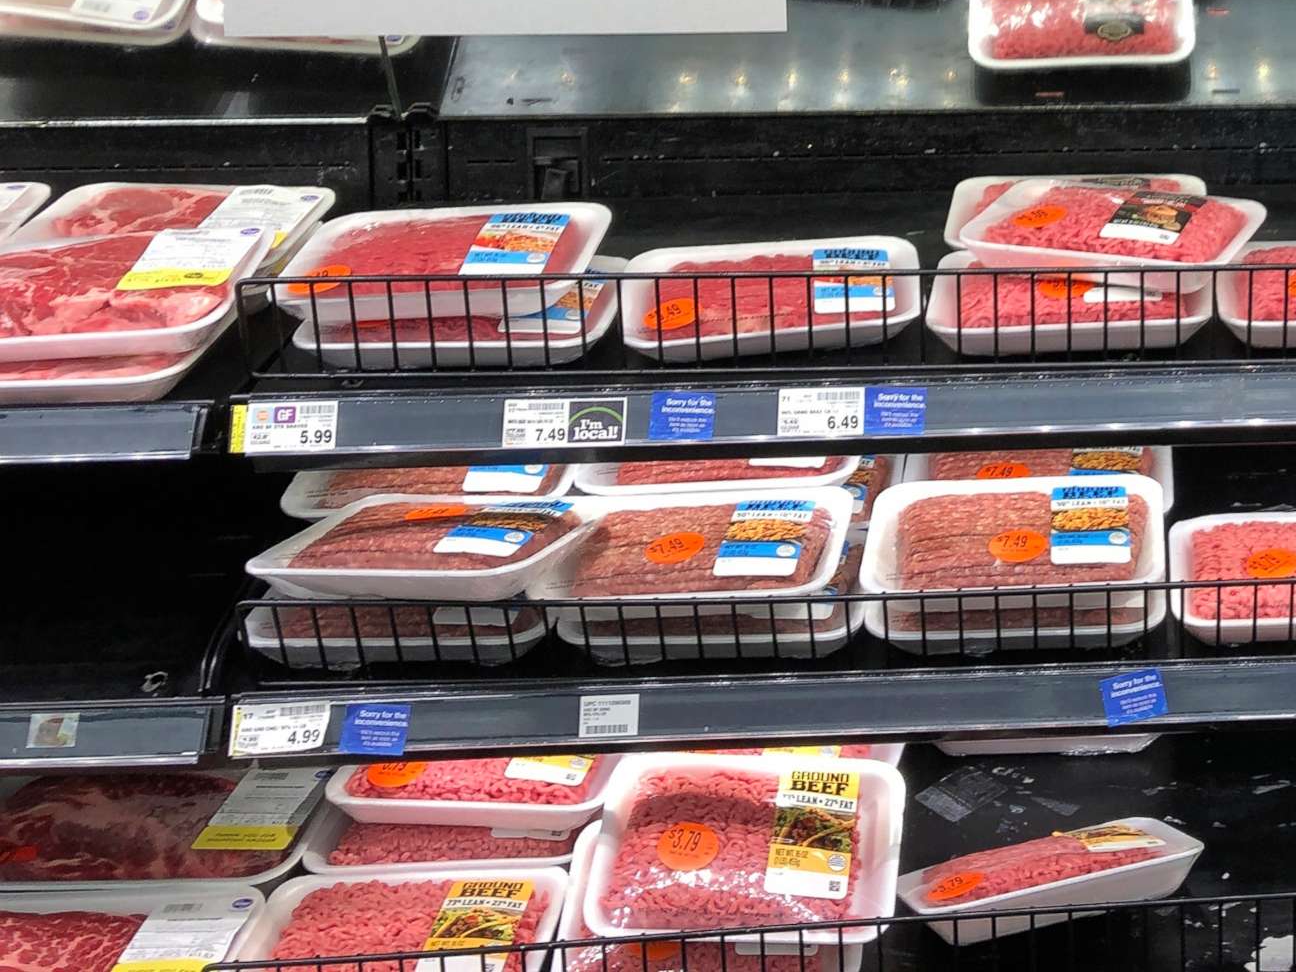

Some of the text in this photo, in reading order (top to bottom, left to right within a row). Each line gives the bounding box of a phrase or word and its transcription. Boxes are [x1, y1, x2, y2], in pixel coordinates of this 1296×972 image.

[666, 398, 713, 408] Sorry for the
[877, 393, 898, 402] Sorry
[911, 393, 924, 401] the
[277, 408, 294, 422] GF
[827, 415, 860, 429] 6.49
[580, 419, 602, 429] I'm
[300, 429, 333, 444] 5.99
[535, 428, 566, 442] 7.49
[573, 426, 619, 441] local!
[650, 538, 685, 554] $7.49
[997, 535, 1028, 548] $7.49
[359, 710, 407, 720] Sorry for the
[287, 729, 321, 745] 4.99
[792, 771, 850, 783] GROUND
[790, 781, 849, 796] BEEF
[796, 795, 818, 805] LEAN
[840, 800, 854, 810] FAT
[668, 829, 702, 852] $3.79
[463, 881, 524, 890] GROUND
[460, 889, 521, 898] BEEF
